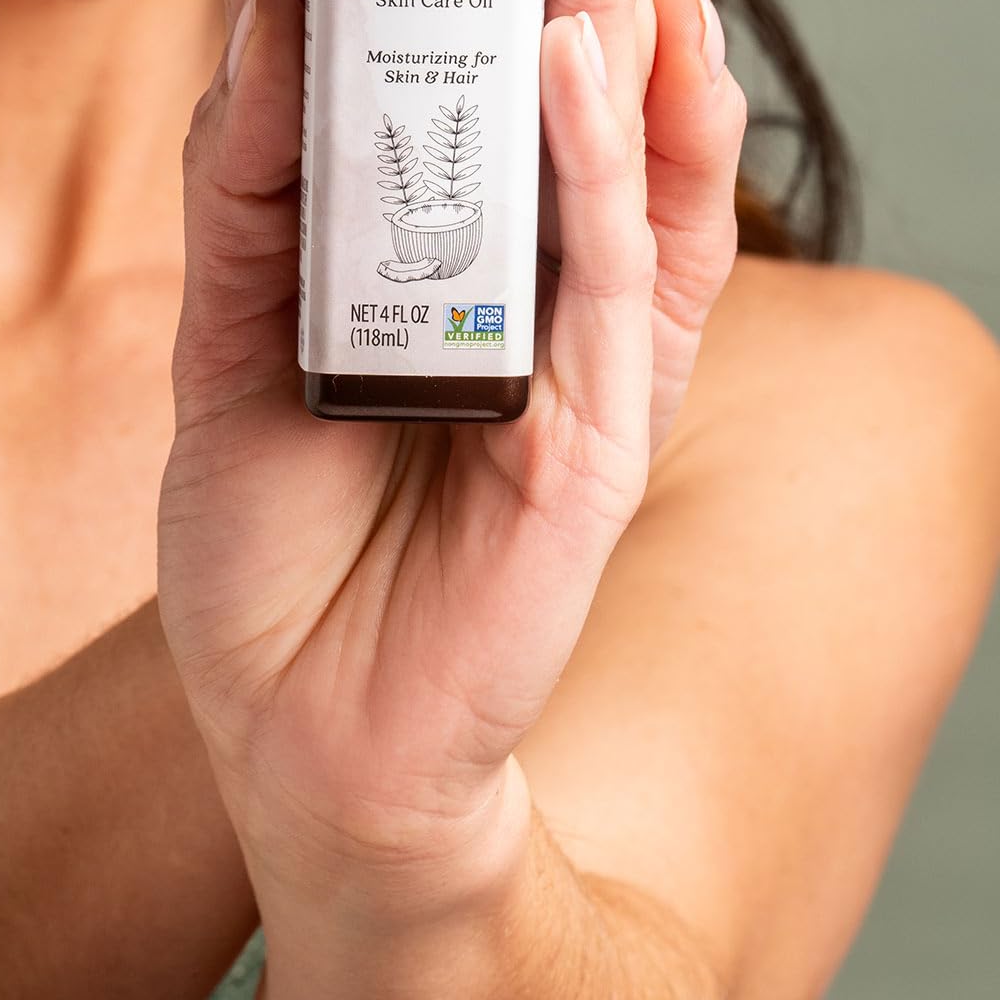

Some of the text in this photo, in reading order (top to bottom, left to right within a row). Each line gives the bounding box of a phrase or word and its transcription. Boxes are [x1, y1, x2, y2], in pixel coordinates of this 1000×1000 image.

[366, 50, 497, 69] Moisturizing for
[384, 70, 479, 85] Skin & Hair
[350, 304, 430, 324] NET 4 FL OZ
[477, 307, 503, 316] NON
[476, 315, 503, 324] GMO
[476, 323, 502, 332] Project
[350, 328, 409, 349] (118mL)
[447, 332, 502, 341] VERIFIED
